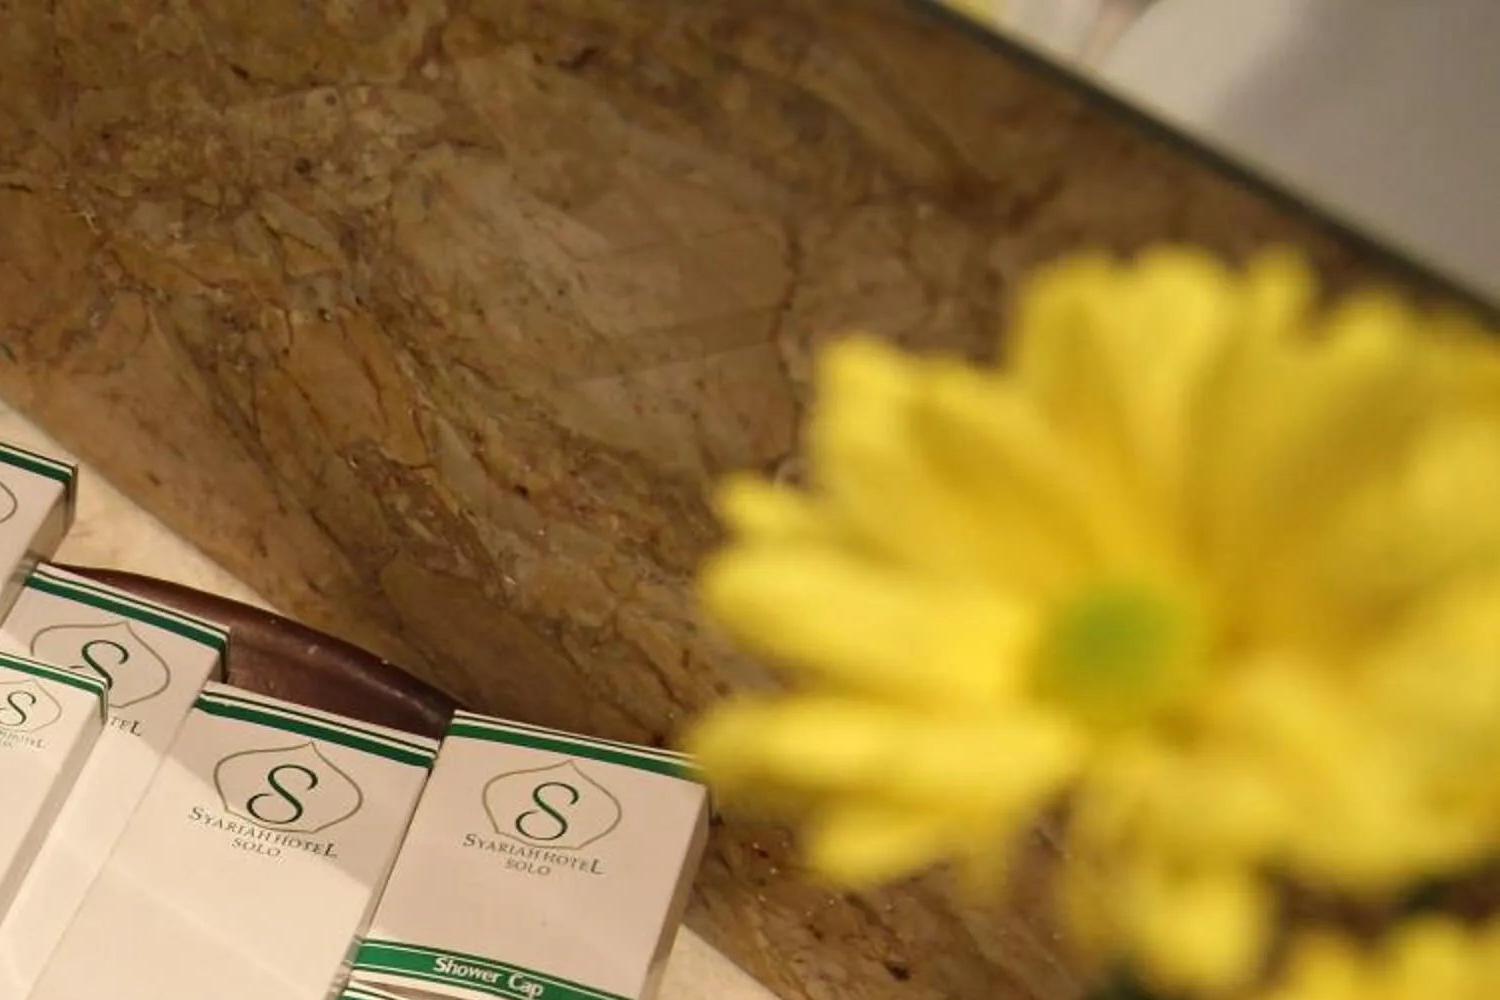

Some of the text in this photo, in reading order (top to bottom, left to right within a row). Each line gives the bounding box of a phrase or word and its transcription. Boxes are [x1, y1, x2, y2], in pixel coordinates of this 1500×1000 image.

[231, 837, 281, 857] SOLO
[505, 858, 551, 876] SOLO
[433, 955, 545, 1000] Shower Cap
